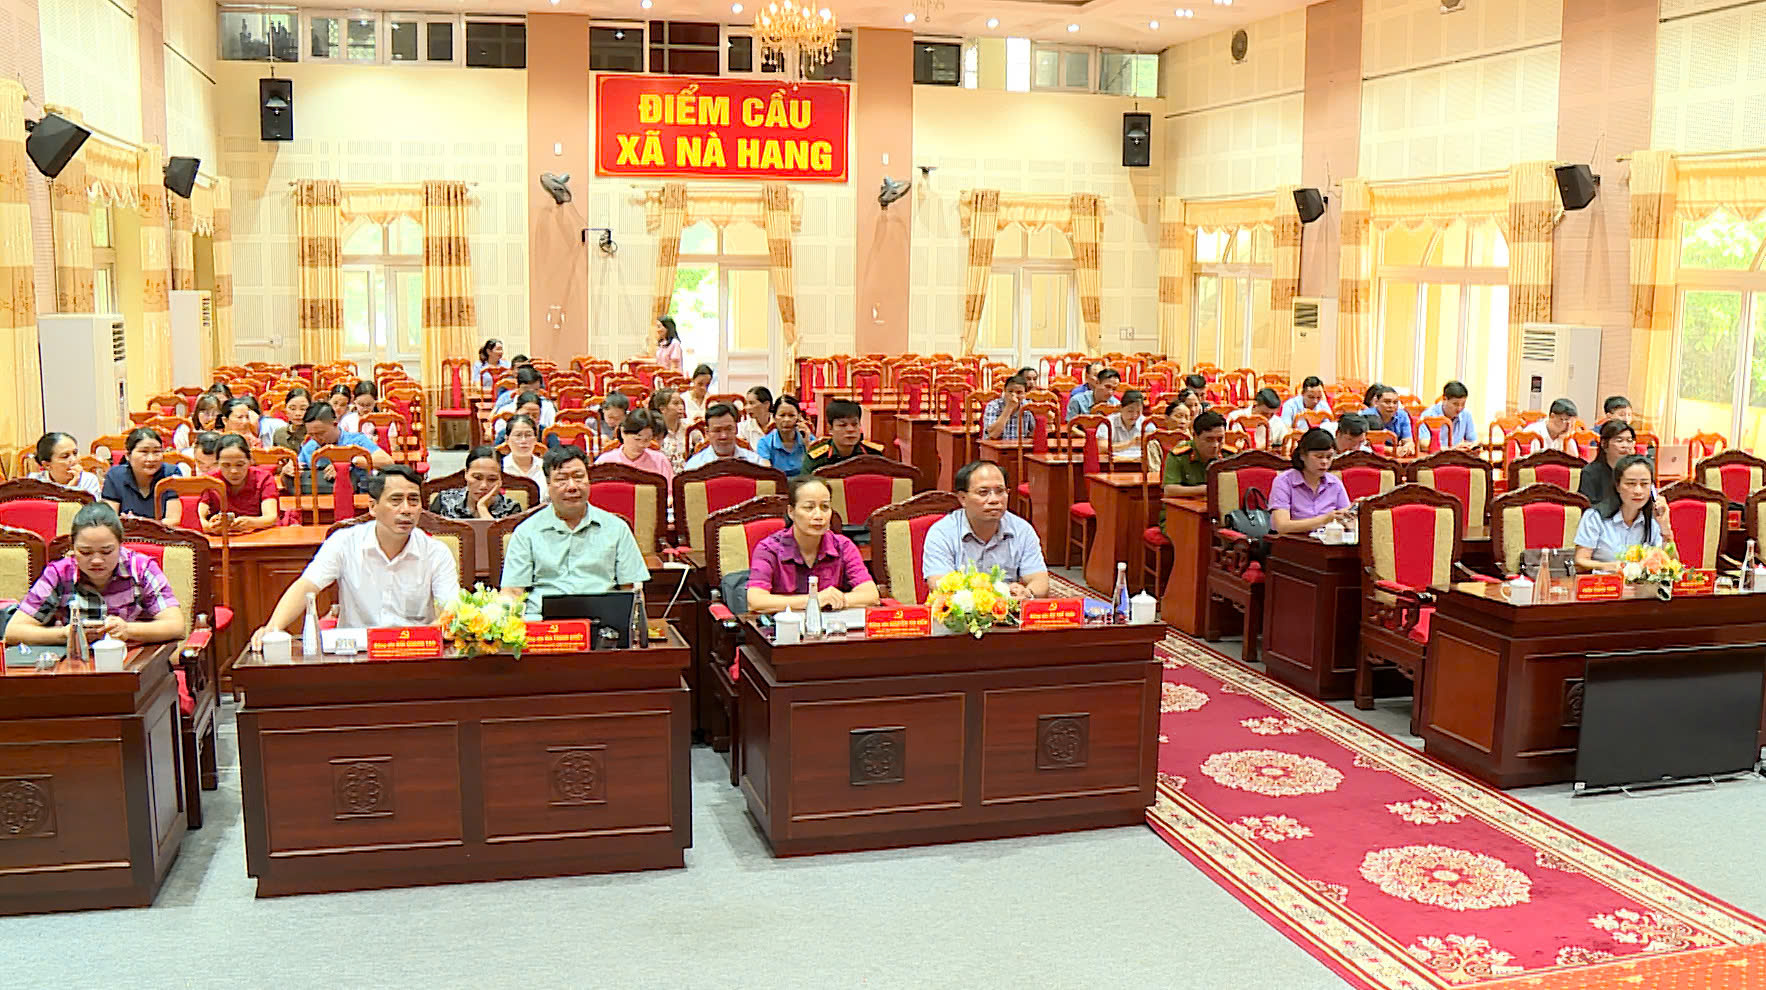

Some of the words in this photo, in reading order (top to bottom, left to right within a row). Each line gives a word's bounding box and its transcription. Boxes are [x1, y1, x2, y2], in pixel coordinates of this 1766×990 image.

[639, 84, 730, 126] ĐIỂM
[742, 88, 812, 129] CẦU
[616, 130, 665, 166] XÃ
[676, 131, 727, 168] NÀ
[737, 138, 833, 171] HANG
